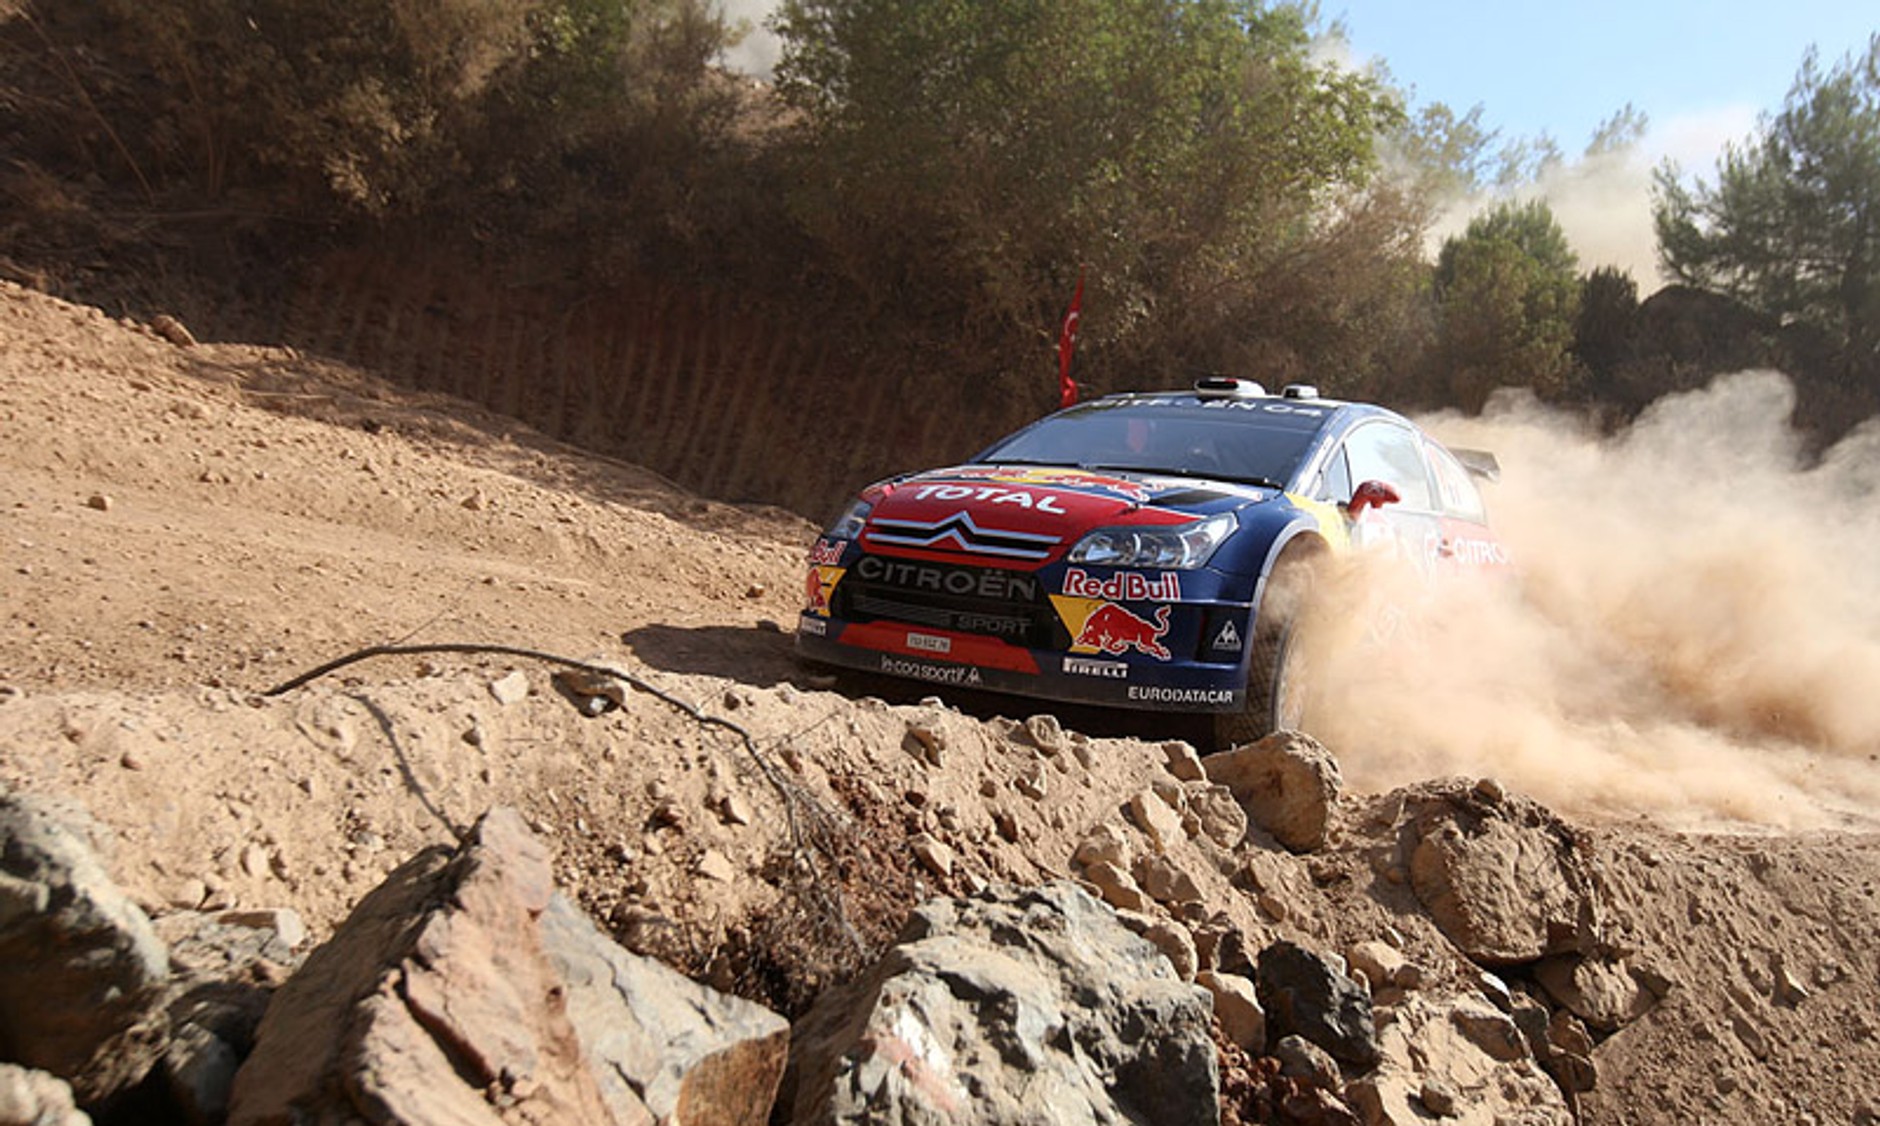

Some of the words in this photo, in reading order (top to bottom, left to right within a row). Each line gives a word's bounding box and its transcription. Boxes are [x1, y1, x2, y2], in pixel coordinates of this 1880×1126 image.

[915, 485, 1066, 513] TOTAL
[857, 556, 1036, 600] CITROËN
[1062, 568, 1124, 600] Red
[1125, 572, 1182, 601] Bull
[957, 615, 1031, 636] SPORT
[1062, 657, 1129, 678] PIRELLI
[1128, 686, 1233, 704] EURODATACAR
